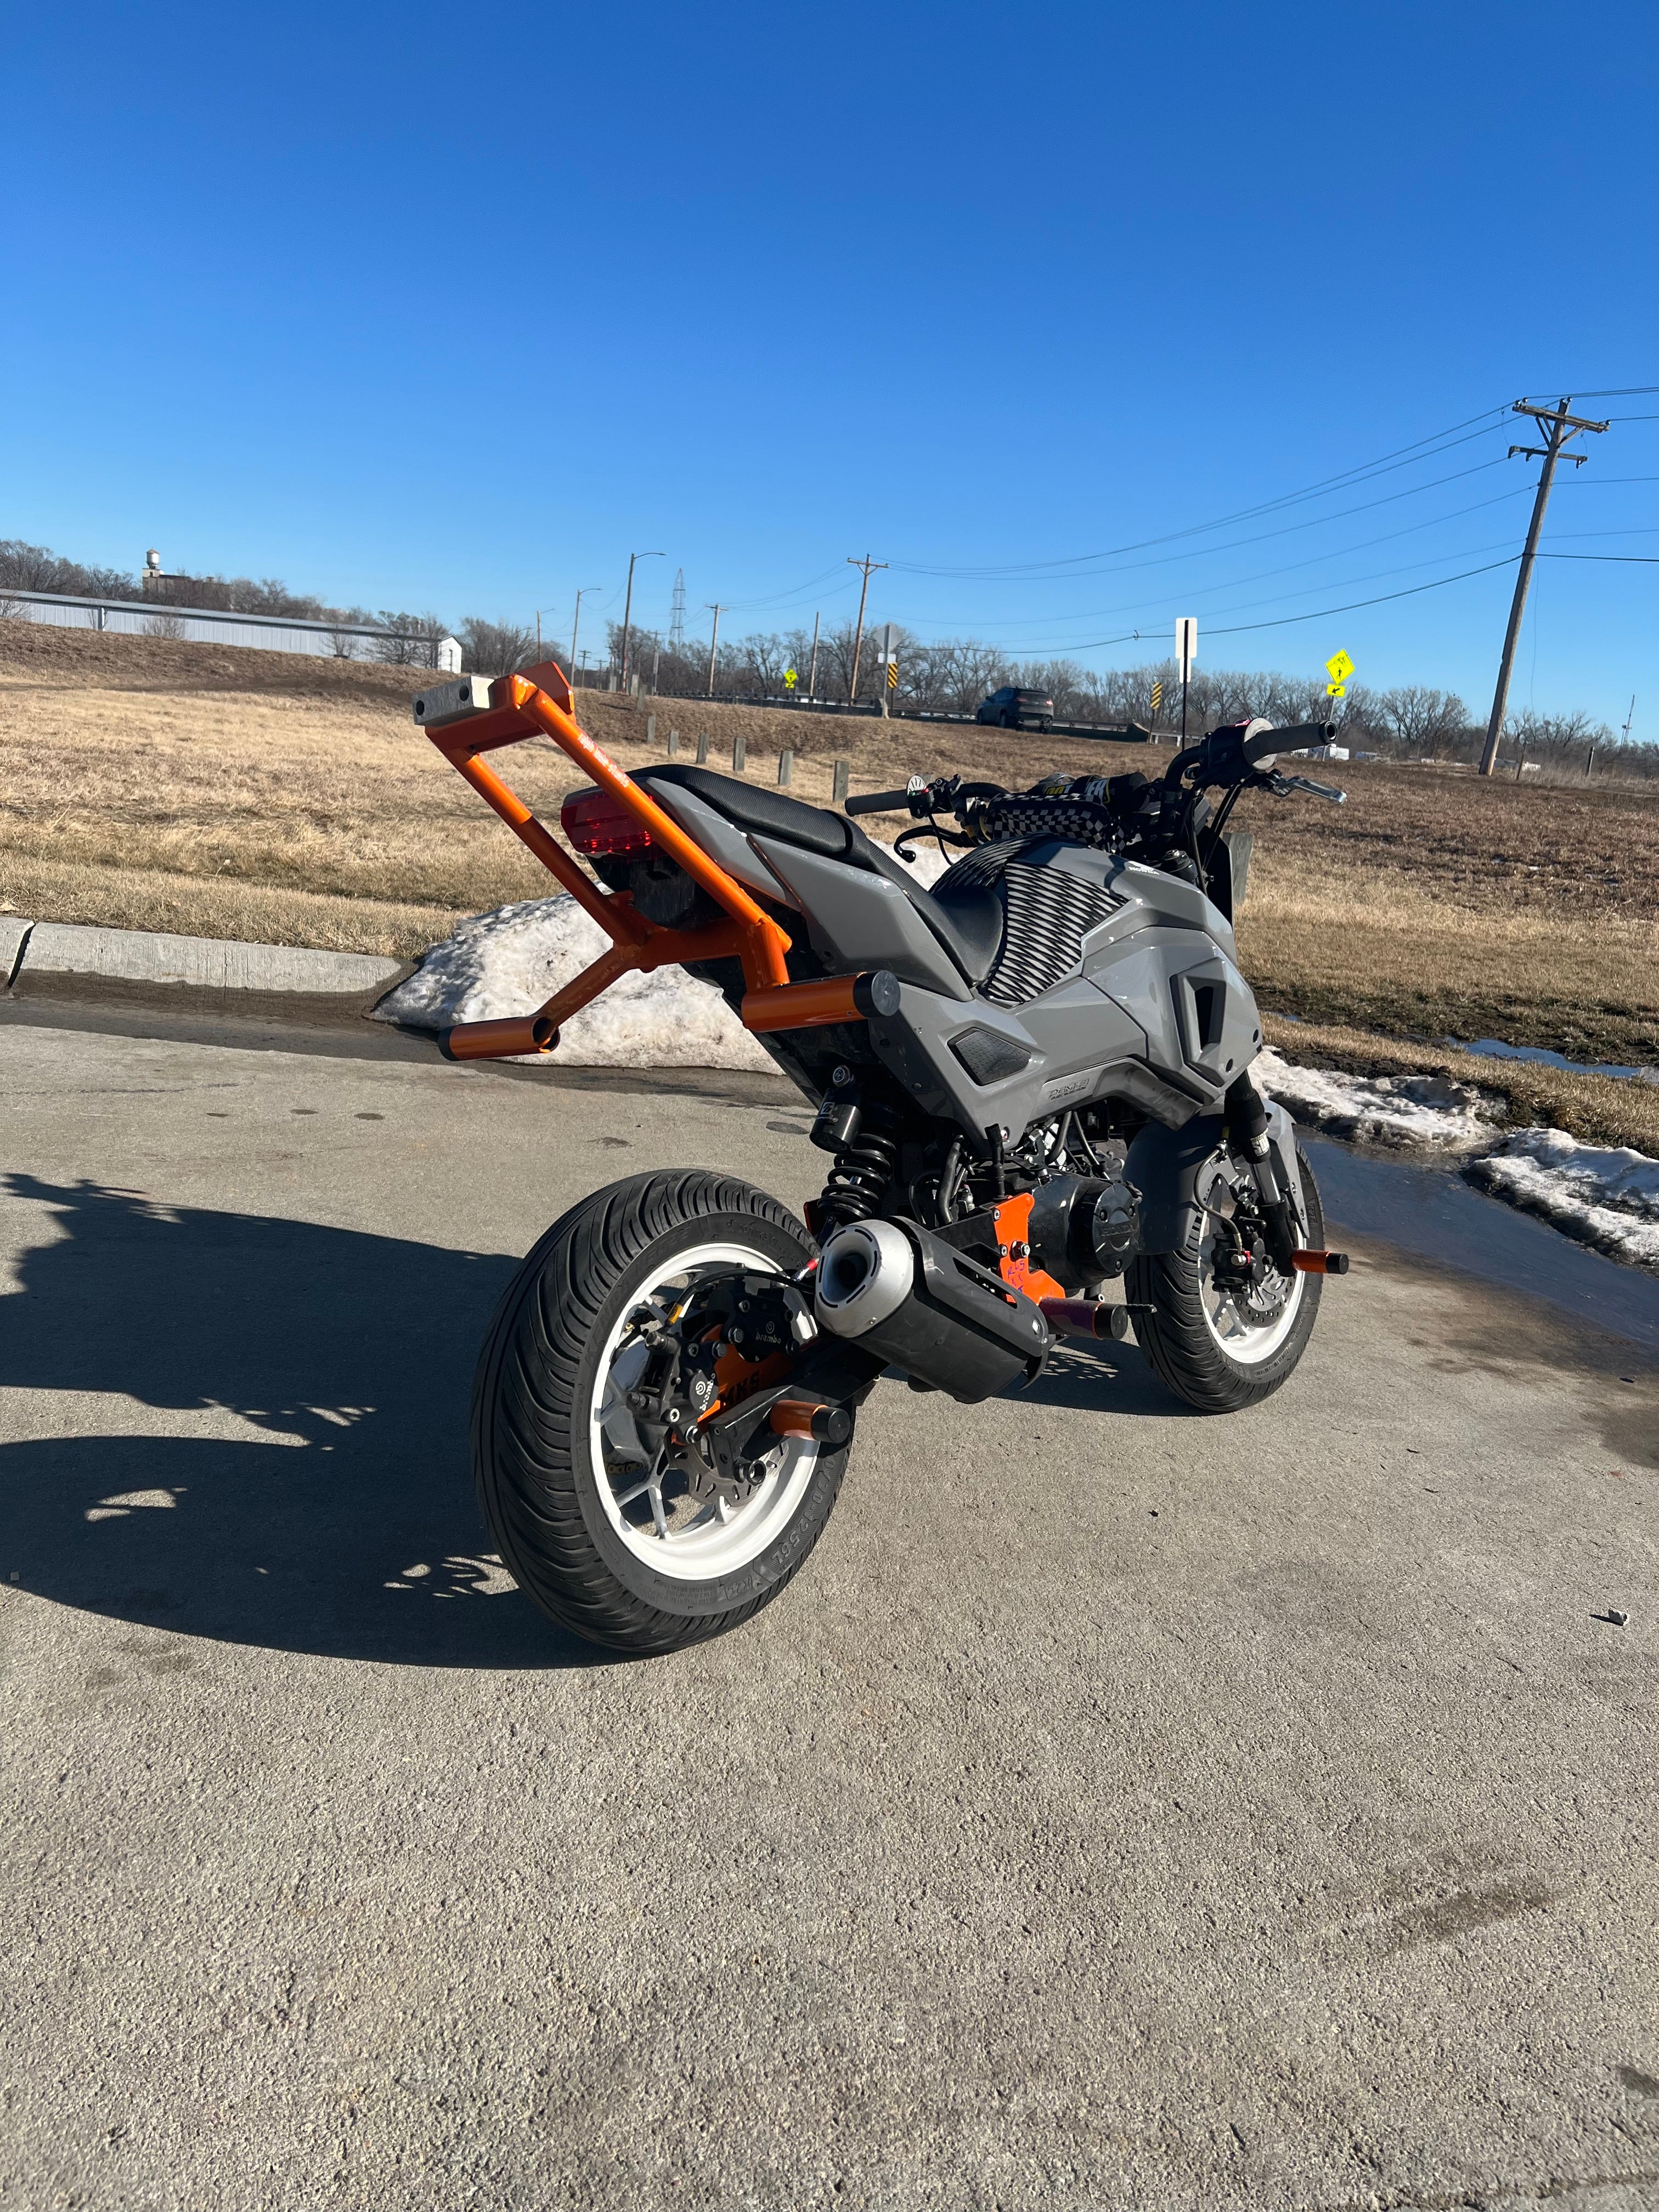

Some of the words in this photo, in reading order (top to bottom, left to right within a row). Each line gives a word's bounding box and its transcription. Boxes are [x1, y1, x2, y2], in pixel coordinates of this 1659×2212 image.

[1128, 866, 1160, 875] HONDA
[1100, 1224, 1138, 1237] HONDA
[755, 1331, 781, 1344] brembo
[699, 1373, 716, 1412] brembo
[797, 1457, 835, 1532] 0/70-12
